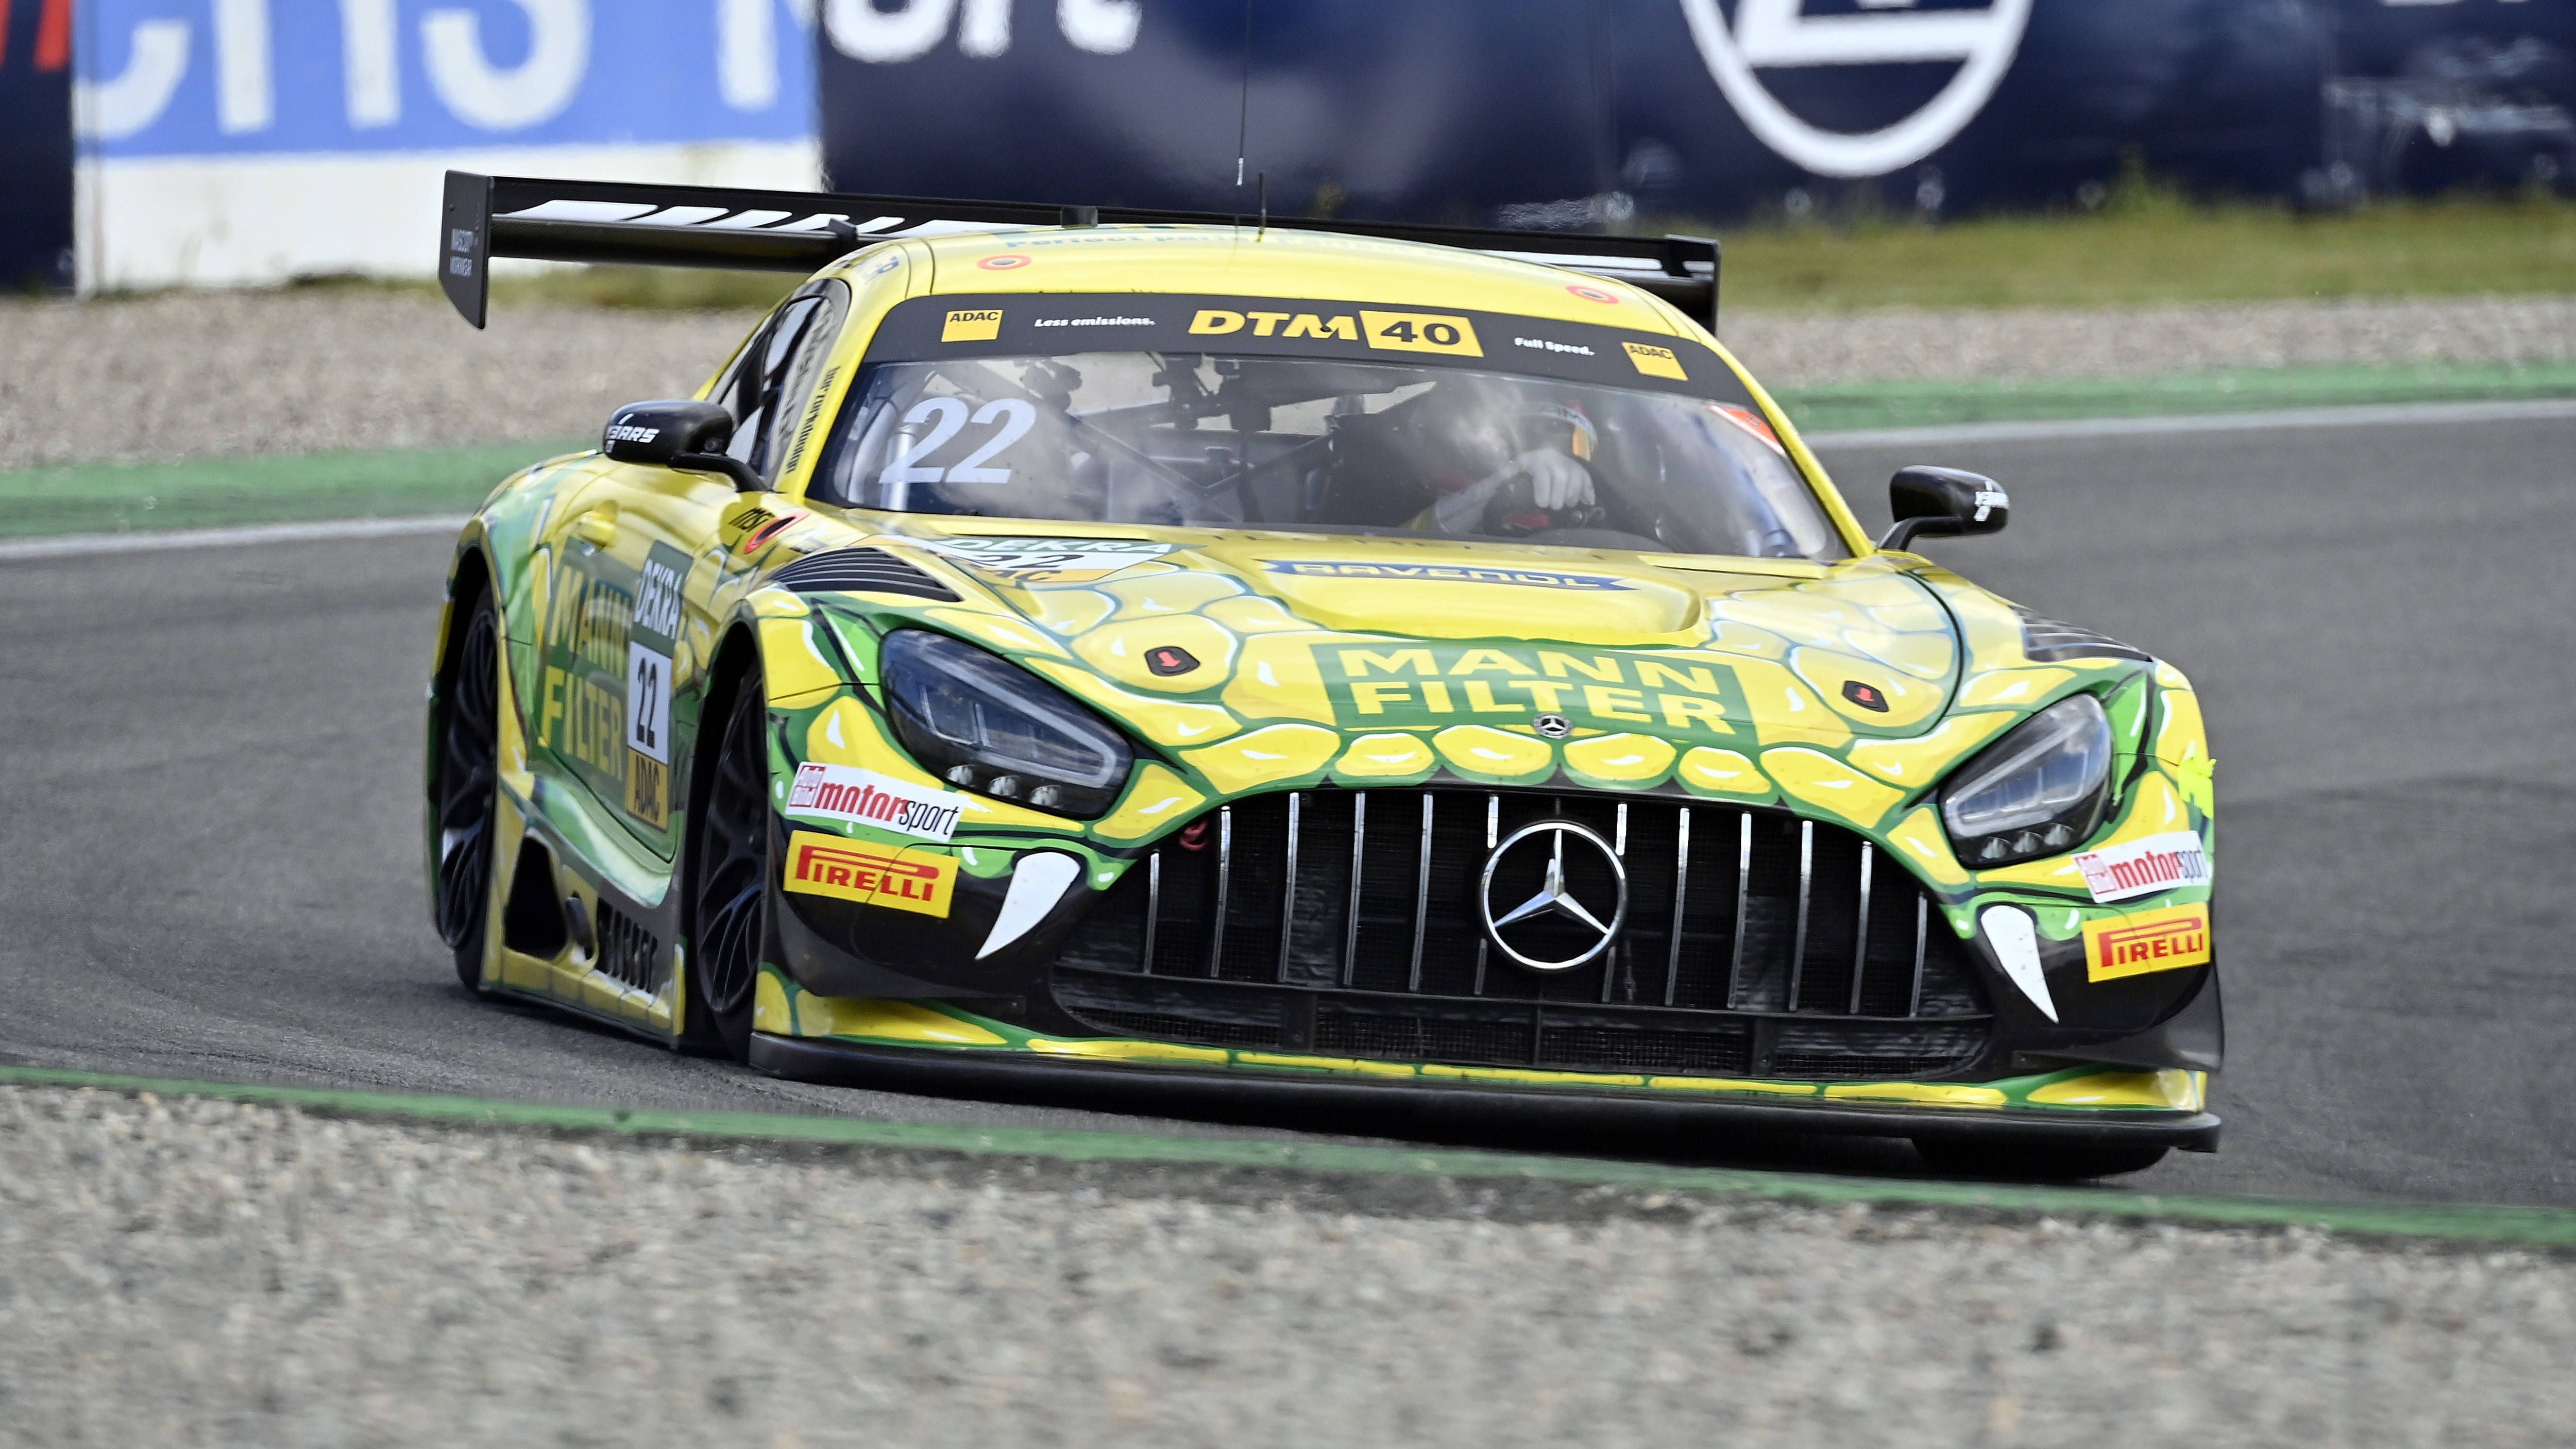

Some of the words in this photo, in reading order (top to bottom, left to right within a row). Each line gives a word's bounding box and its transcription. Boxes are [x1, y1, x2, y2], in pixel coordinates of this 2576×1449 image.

[950, 311, 999, 322] ADAC
[1034, 319, 1069, 327] Less
[1071, 316, 1156, 326] emissions.
[1188, 310, 1359, 341] DTM
[1381, 321, 1461, 346] 40
[1514, 337, 1544, 349] Full
[1545, 340, 1596, 356] Speed.
[1629, 344, 1673, 360] ADAC
[878, 397, 1037, 484] 22
[942, 538, 1173, 553] DEKRA
[971, 554, 1086, 568] 22
[1292, 563, 1601, 587] RAVENOL
[634, 559, 683, 640] DEKRA
[1338, 649, 1721, 695] MANN
[539, 665, 623, 783] FILTER
[637, 657, 658, 749] 22
[1350, 680, 1737, 735] FILTER
[815, 781, 959, 835] motorsport
[795, 845, 940, 902] PIRELLI
[2098, 917, 2203, 968] PIRELLI
